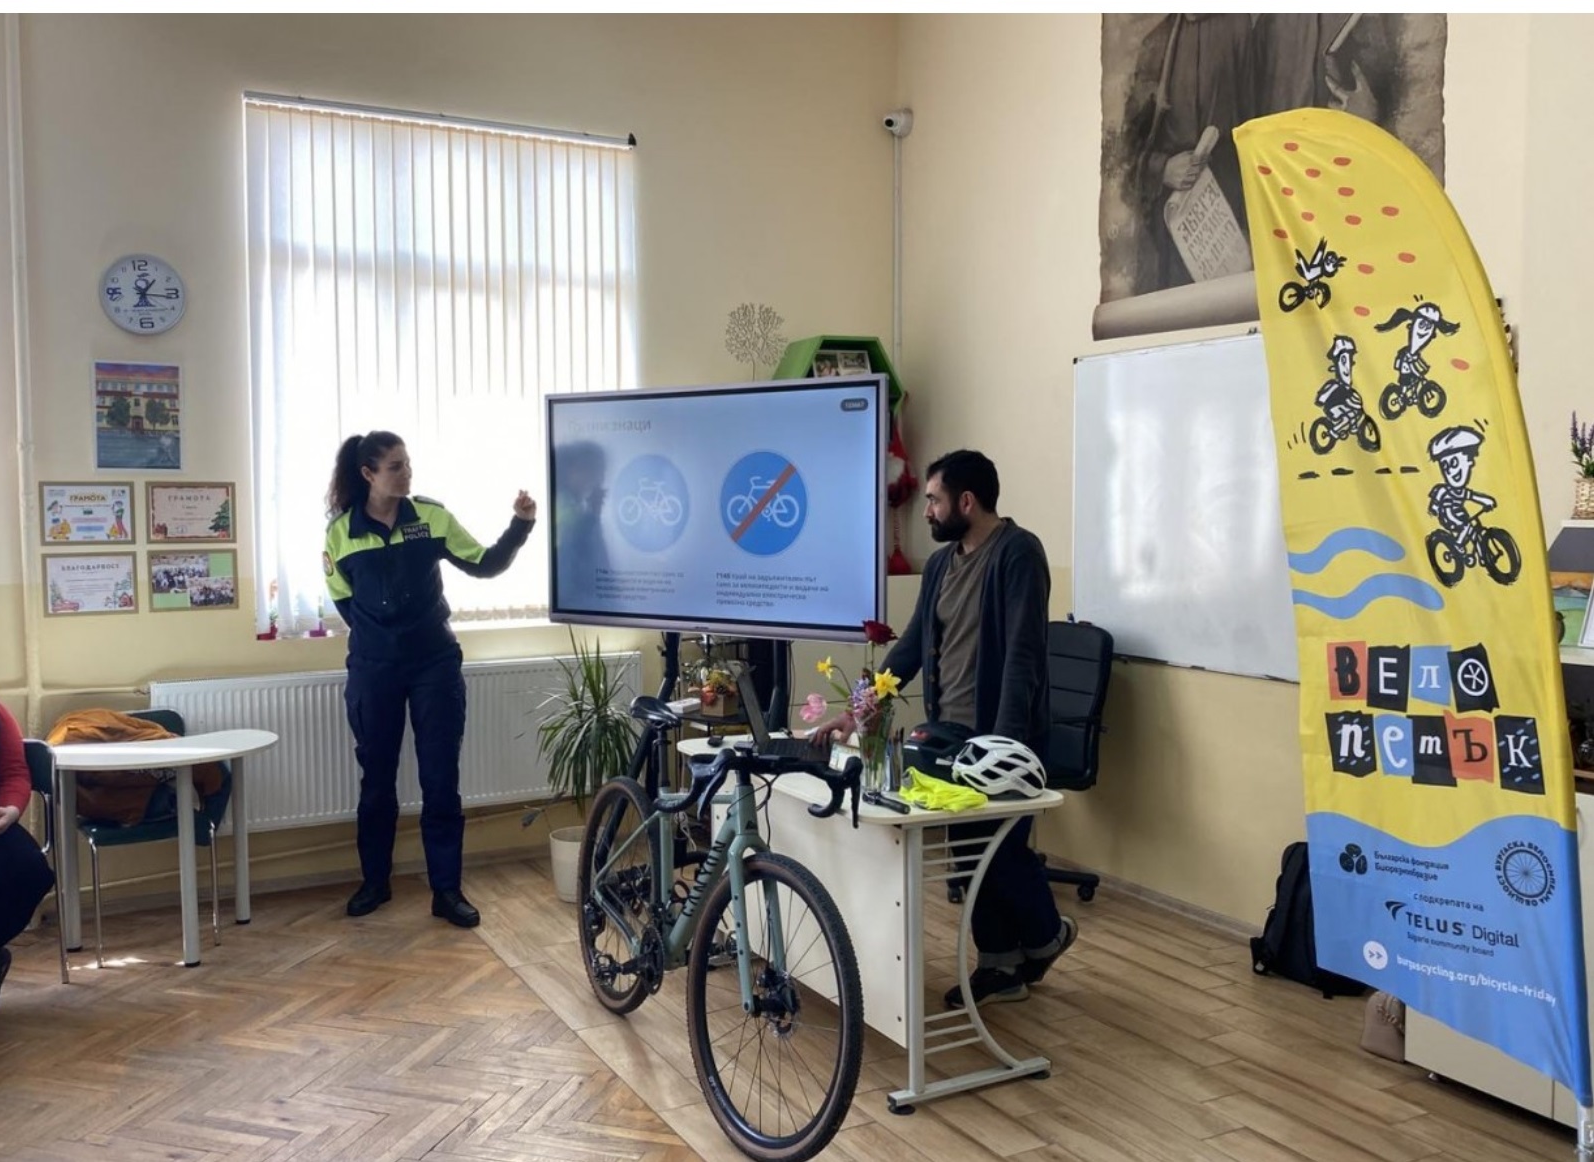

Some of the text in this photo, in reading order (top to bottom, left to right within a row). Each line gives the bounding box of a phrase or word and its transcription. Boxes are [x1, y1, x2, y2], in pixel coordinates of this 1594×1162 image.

[132, 259, 148, 272] 12
[164, 288, 179, 299] 3
[139, 317, 155, 329] 6
[69, 494, 106, 502] ГРАМОТА
[168, 494, 211, 502] ГРАМОТА
[404, 531, 430, 540] POLICE
[682, 840, 727, 917] CANYON
[1419, 894, 1471, 910] подкрепата
[1472, 902, 1484, 912] на
[1405, 911, 1520, 948] TELUS Digital
[1430, 936, 1471, 954] community
[1471, 945, 1495, 957] board
